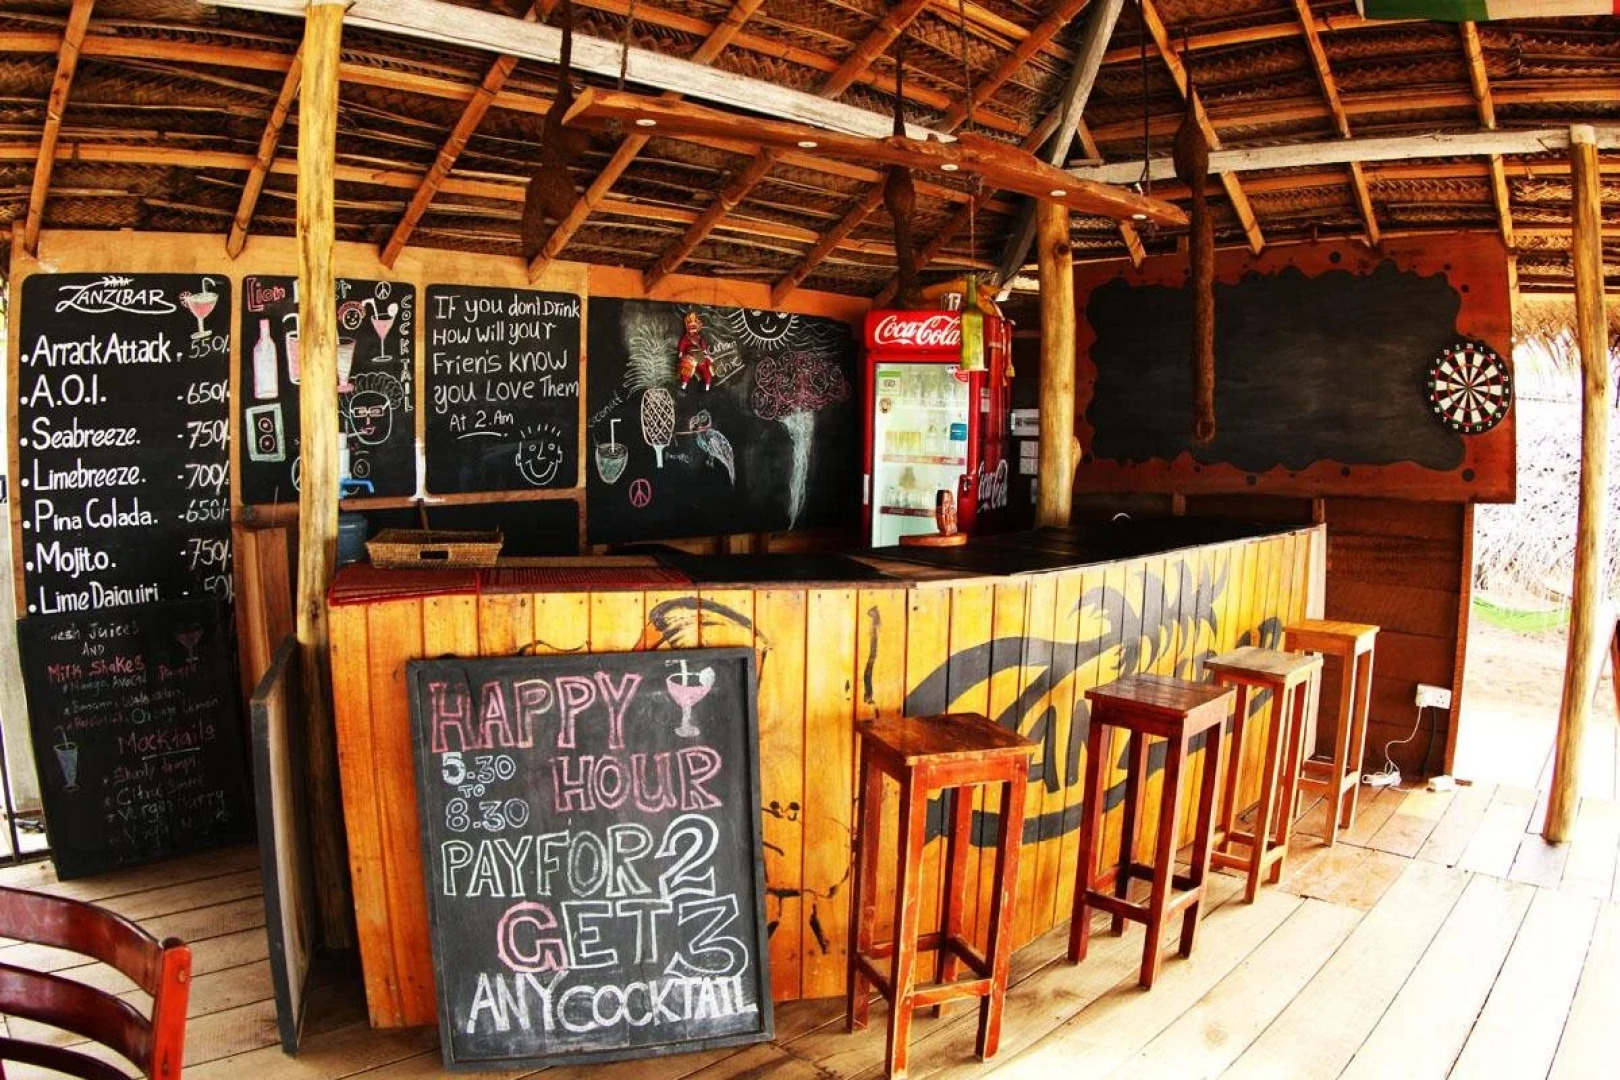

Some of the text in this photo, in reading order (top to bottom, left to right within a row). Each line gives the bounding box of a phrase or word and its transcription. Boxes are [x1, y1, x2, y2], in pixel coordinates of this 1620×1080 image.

[55, 275, 177, 314] ZANZIBAR
[463, 298, 503, 323] you
[542, 300, 580, 318] Drink
[476, 321, 505, 342] Will
[508, 321, 556, 345] your
[874, 315, 960, 346] Coca-Cola
[30, 334, 102, 367] Arrack
[399, 294, 414, 413] COCKTAIL
[434, 381, 477, 414] you
[539, 374, 579, 398] Them
[31, 417, 141, 450] Seabreeze.
[450, 413, 467, 431] At
[34, 459, 147, 492] Limebreeze.
[35, 499, 82, 532] Pina
[85, 498, 159, 530] Colada.
[35, 541, 117, 578] Mojito.
[39, 585, 90, 615] Lime
[428, 671, 643, 753] HAPPY
[441, 746, 723, 813] 5.30 HOUR
[459, 784, 485, 799] TO
[445, 798, 529, 832] 8.30
[441, 813, 719, 901] PAY FOR 2
[496, 894, 749, 978] GET 3
[467, 970, 757, 1034] ANY COCKTAIL
